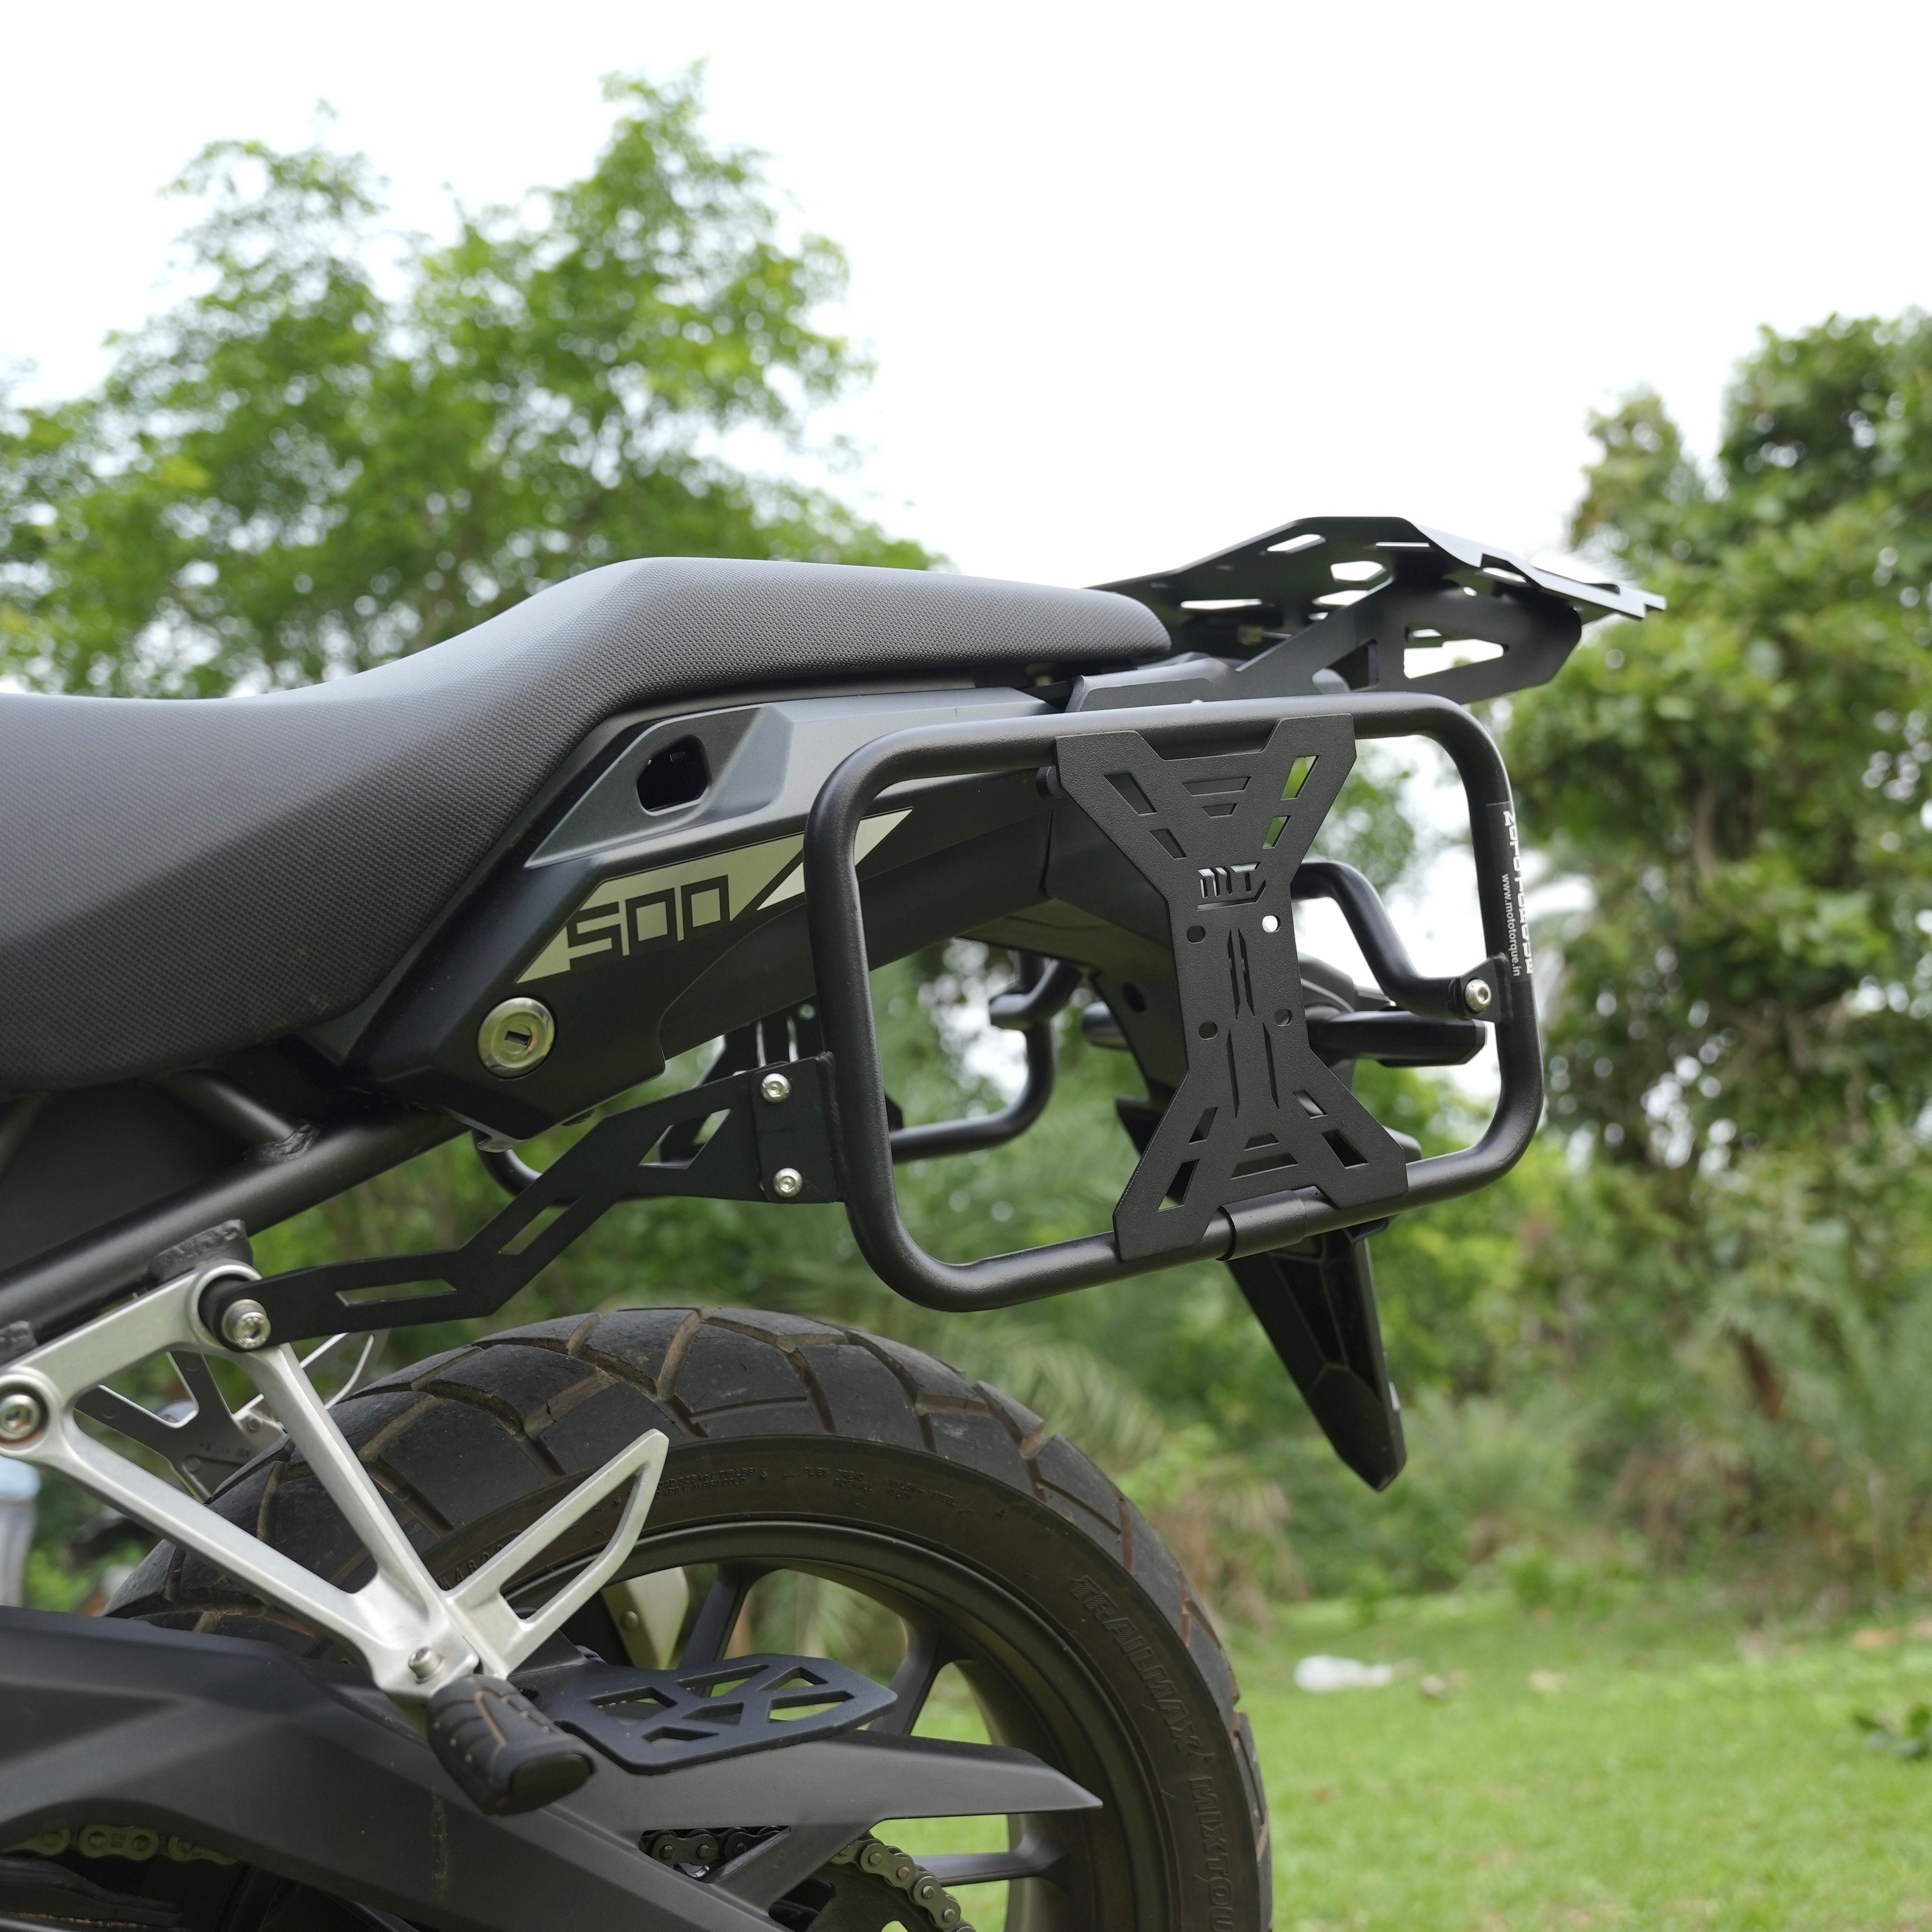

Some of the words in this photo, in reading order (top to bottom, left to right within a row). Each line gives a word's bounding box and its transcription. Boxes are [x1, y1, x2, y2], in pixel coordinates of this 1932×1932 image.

[1501, 873, 1521, 977] www.mototorque.in
[658, 1477, 676, 1489] OAD
[1071, 1574, 1201, 1756] TRAILMAX
